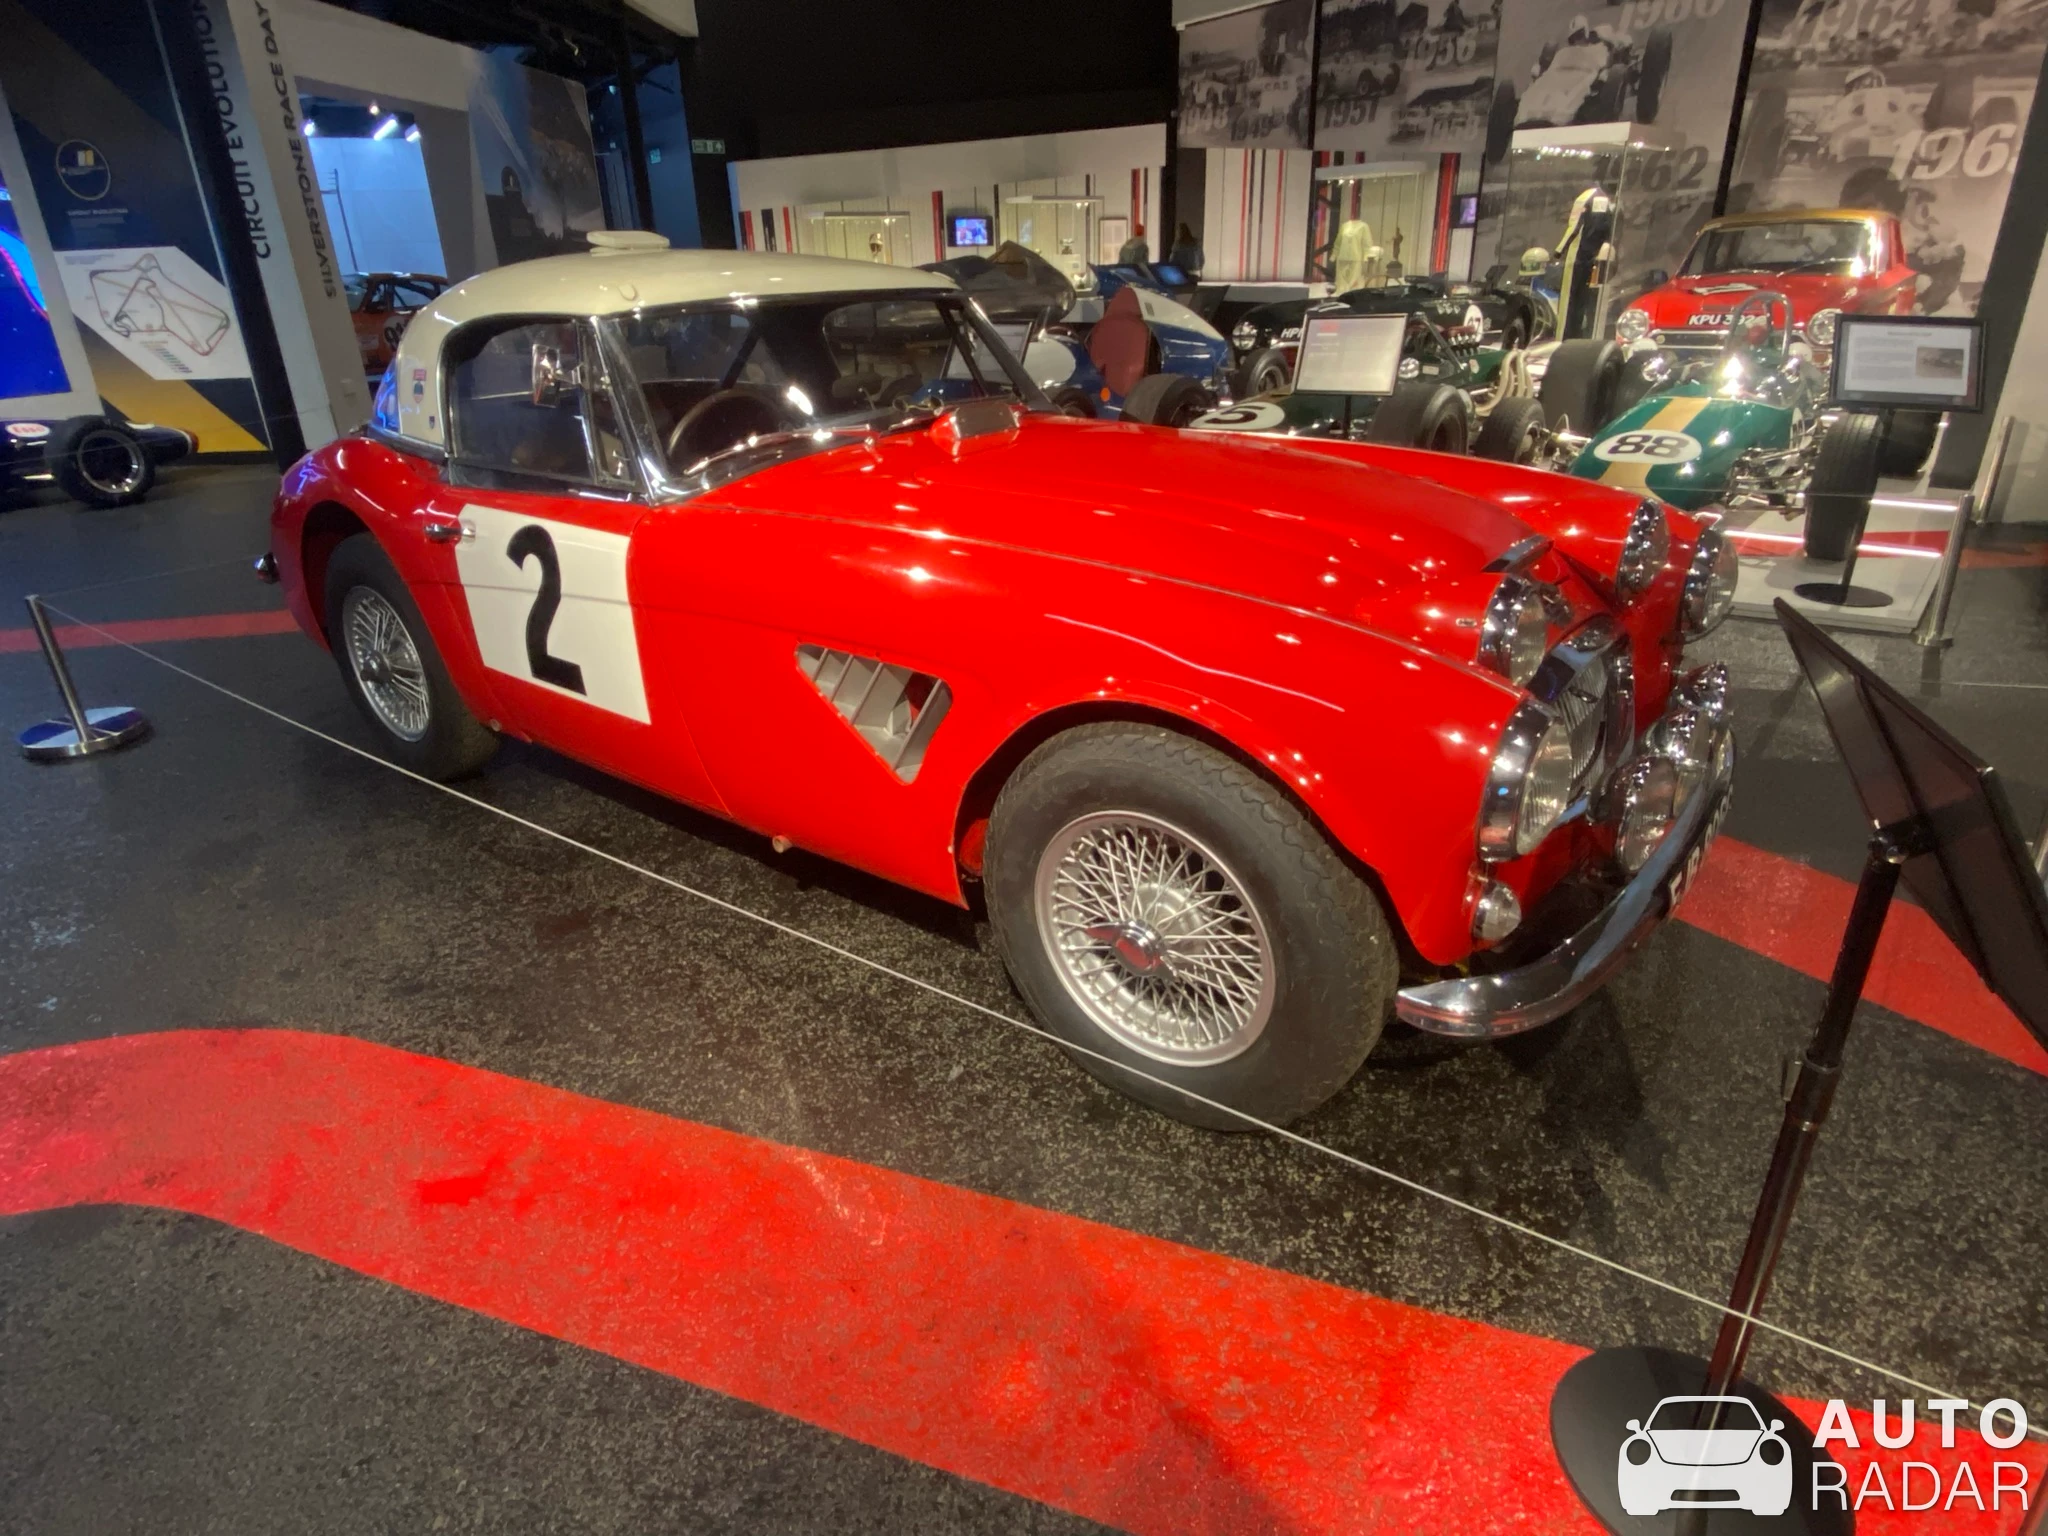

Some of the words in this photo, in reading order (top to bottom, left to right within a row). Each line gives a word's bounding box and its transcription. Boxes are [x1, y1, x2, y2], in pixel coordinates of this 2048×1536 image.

[254, 0, 279, 55] DAY
[270, 61, 297, 131] RACE
[1887, 123, 2018, 181] 196
[231, 158, 271, 260] CIRCUIT
[289, 138, 337, 300] SILVERSTONE
[1688, 314, 1722, 326] KPU
[1204, 404, 1267, 425] 5
[1607, 434, 1690, 459] 88
[506, 523, 587, 697] 2
